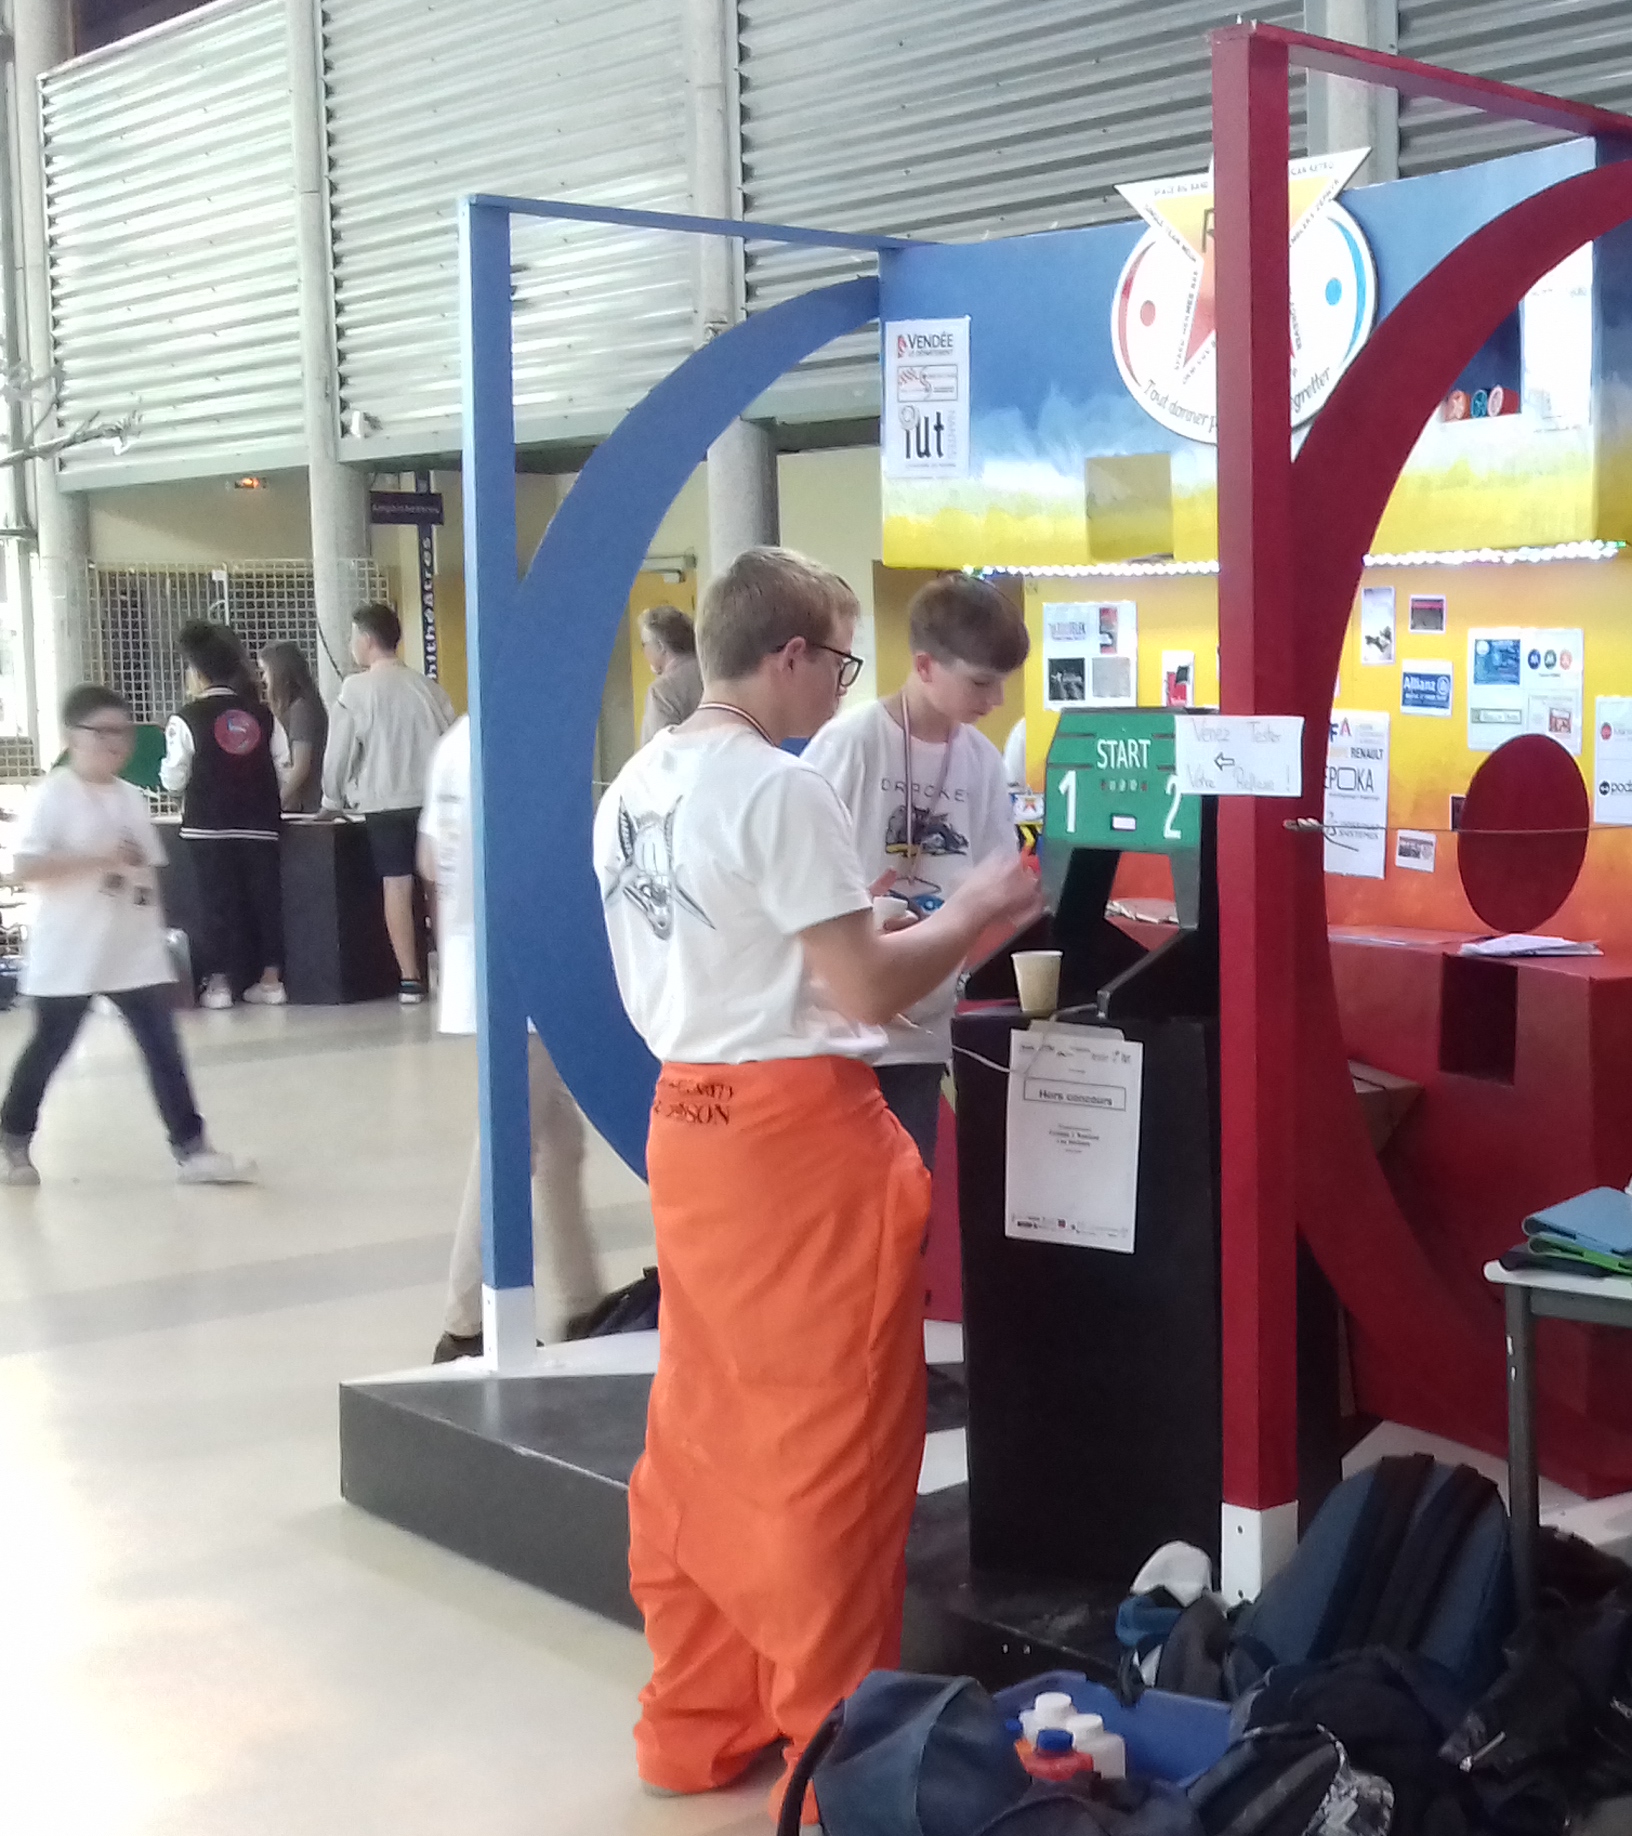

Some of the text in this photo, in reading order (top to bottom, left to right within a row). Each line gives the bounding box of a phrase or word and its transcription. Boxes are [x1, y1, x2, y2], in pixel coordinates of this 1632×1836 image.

[907, 331, 953, 349] VENDÉE
[901, 405, 944, 459] iut
[1403, 675, 1436, 693] Allianz
[1096, 738, 1151, 770] START
[1350, 746, 1384, 761] RENAULT
[1058, 770, 1182, 840] 1 2
